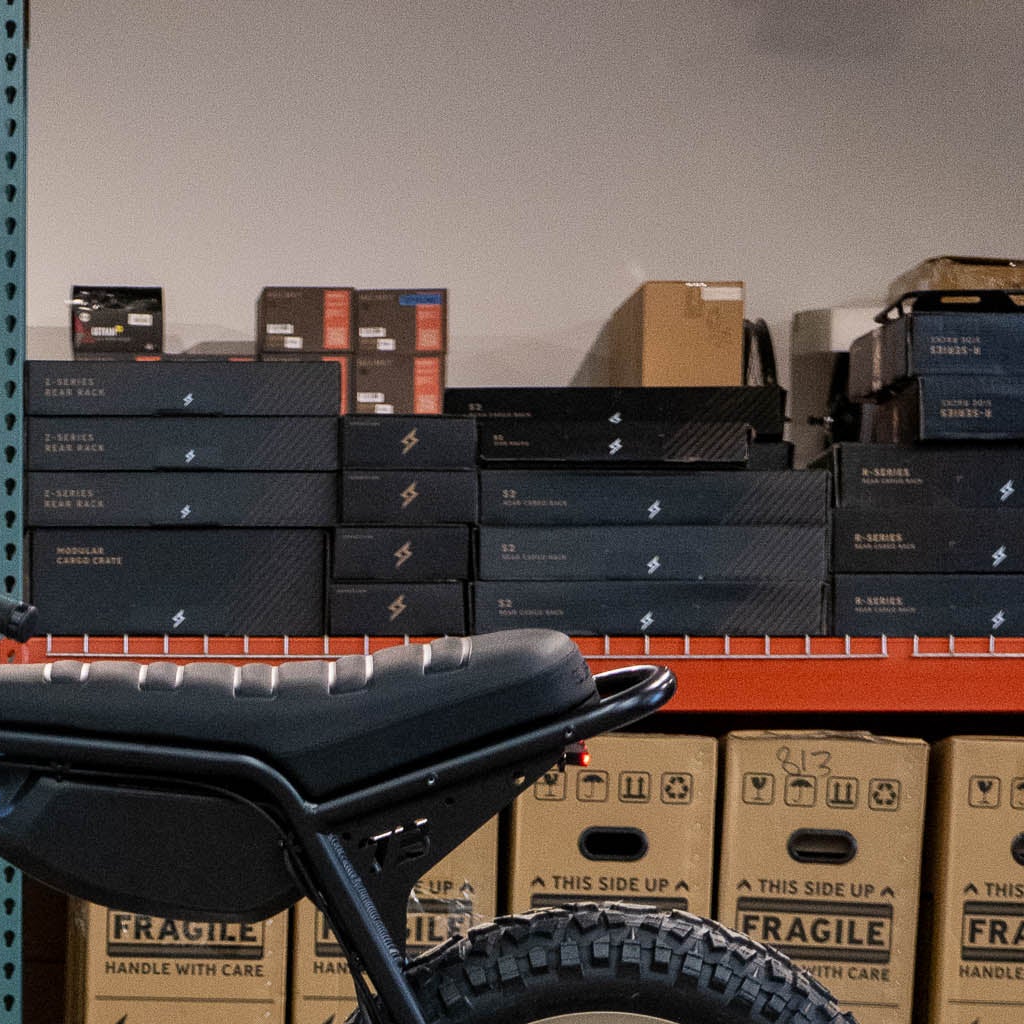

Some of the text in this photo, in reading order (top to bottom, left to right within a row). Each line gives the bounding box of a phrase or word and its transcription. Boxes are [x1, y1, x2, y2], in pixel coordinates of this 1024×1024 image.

[862, 467, 911, 477] R-SERIES
[502, 489, 517, 498] S2
[854, 532, 903, 542] R-SERIES
[56, 546, 104, 555] MODULAR
[501, 544, 516, 552] S2
[56, 557, 122, 565] CARGO CRATE
[498, 599, 513, 607] S2
[428, 880, 453, 894] UP
[551, 875, 669, 891] THIS SIDE UP
[758, 879, 875, 897] THIS SIDE UP
[984, 882, 1024, 898] THIS
[113, 914, 258, 943] FRAGILE
[742, 914, 886, 946] FRAGILE
[105, 961, 264, 977] HANDLE WITH CARE
[313, 961, 349, 974] HAN
[847, 966, 890, 982] CARE
[959, 965, 1024, 980] HANDLE
